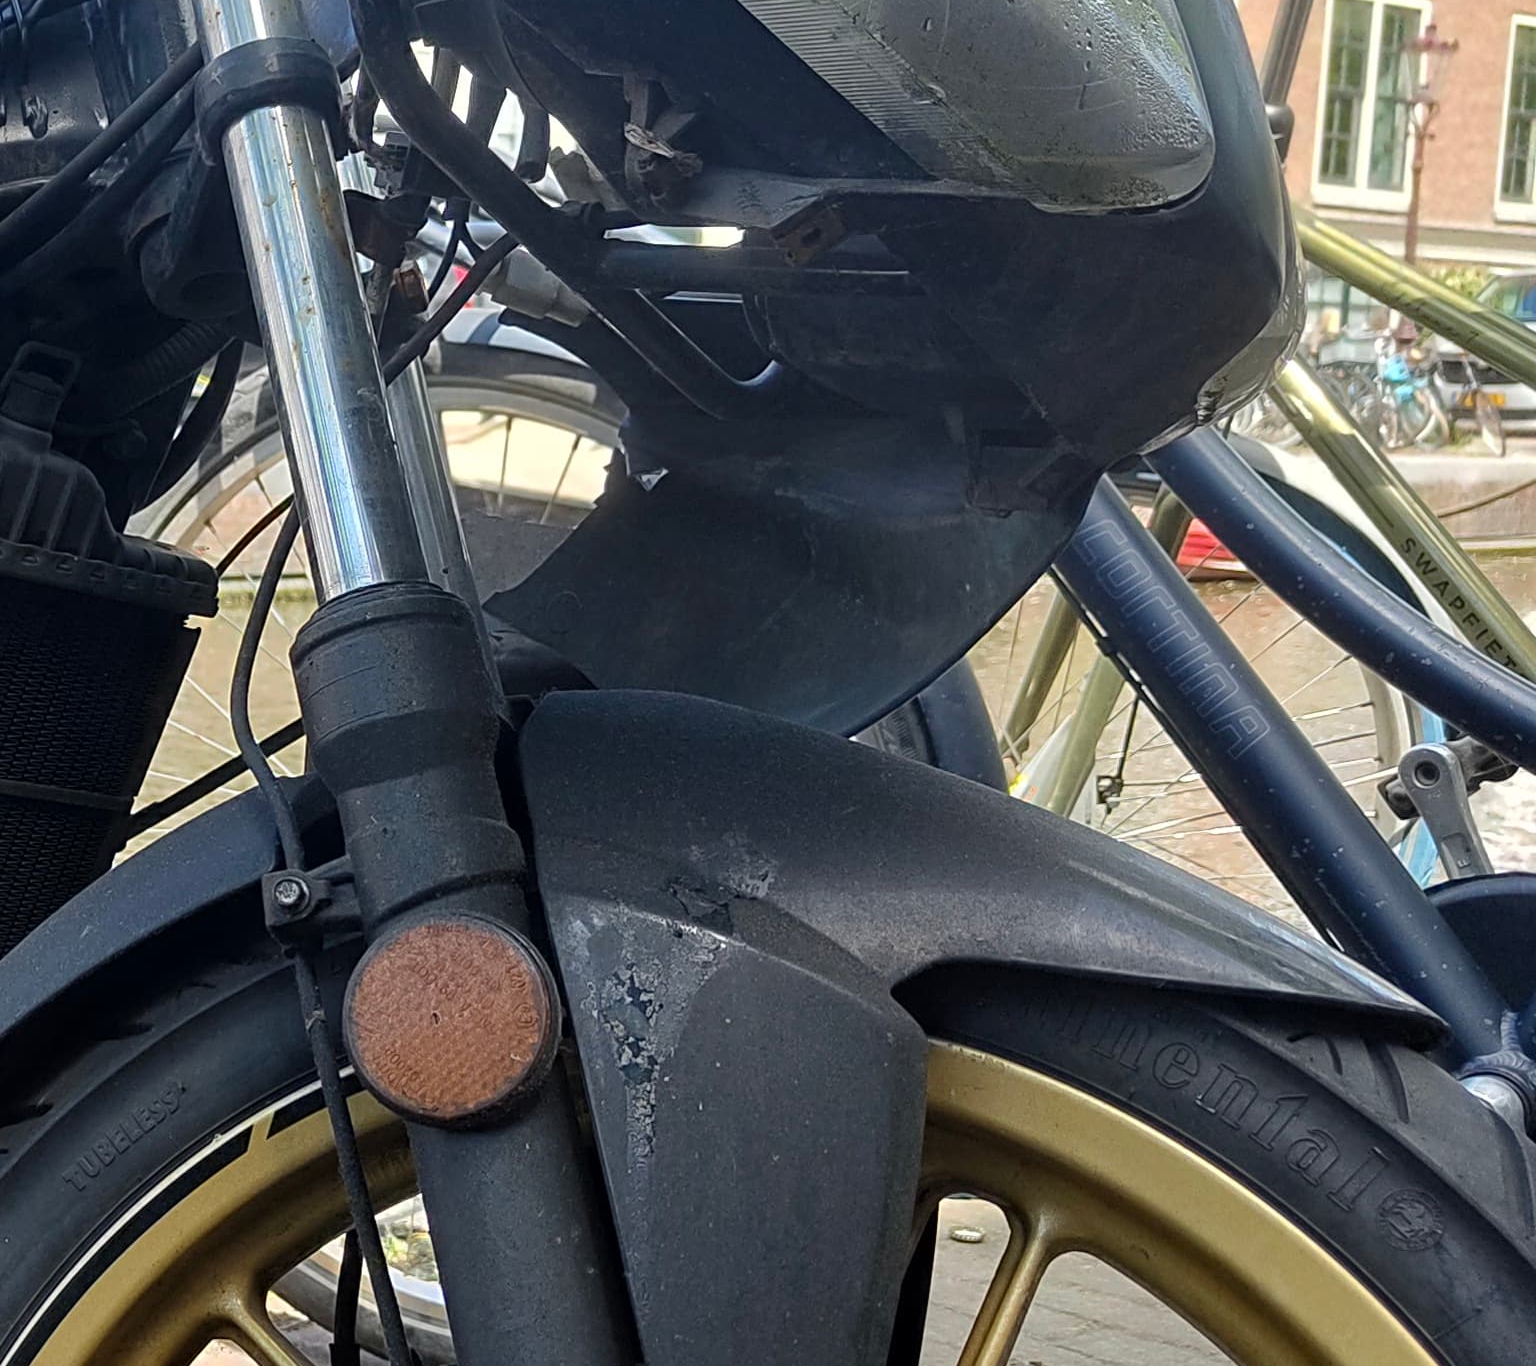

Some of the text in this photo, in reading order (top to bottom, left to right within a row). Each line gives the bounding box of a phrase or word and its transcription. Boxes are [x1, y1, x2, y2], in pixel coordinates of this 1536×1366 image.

[1072, 519, 1270, 760] CORTINA
[1401, 537, 1519, 671] SWAPFIET
[61, 1081, 181, 1193] TUBELESS
